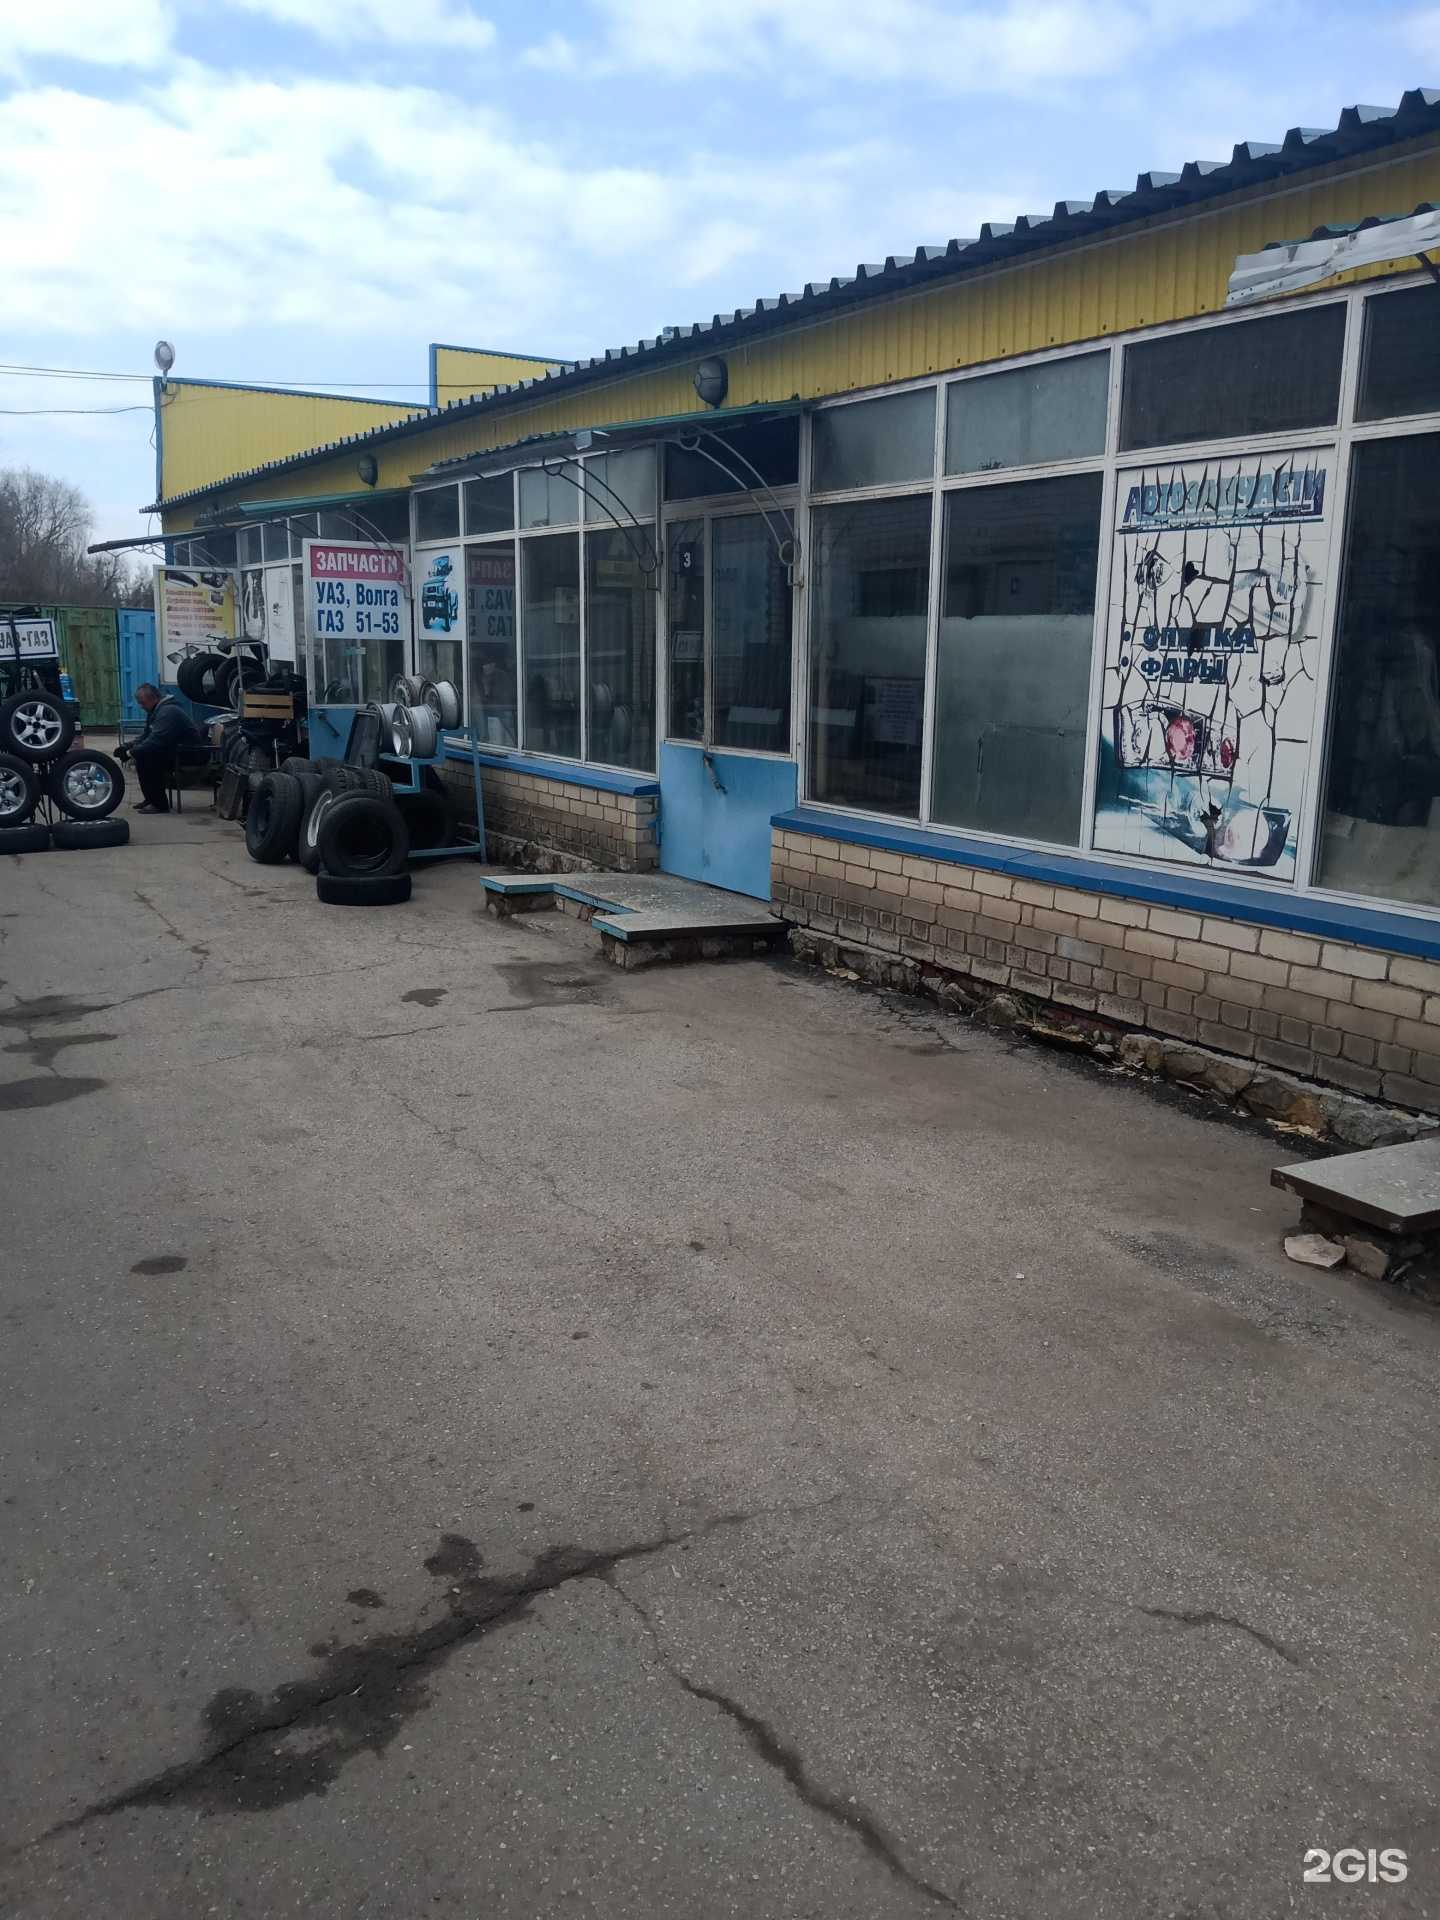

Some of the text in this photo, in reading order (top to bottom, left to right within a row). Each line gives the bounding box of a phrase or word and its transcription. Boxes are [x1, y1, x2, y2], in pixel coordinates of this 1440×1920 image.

[316, 551, 398, 574] ЗАПЧАСТИ
[683, 552, 691, 568] 3
[316, 581, 398, 608] УАЗ, Волга
[317, 609, 399, 633] ГАЗ 51-53
[1141, 657, 1228, 684] ФАРЫ
